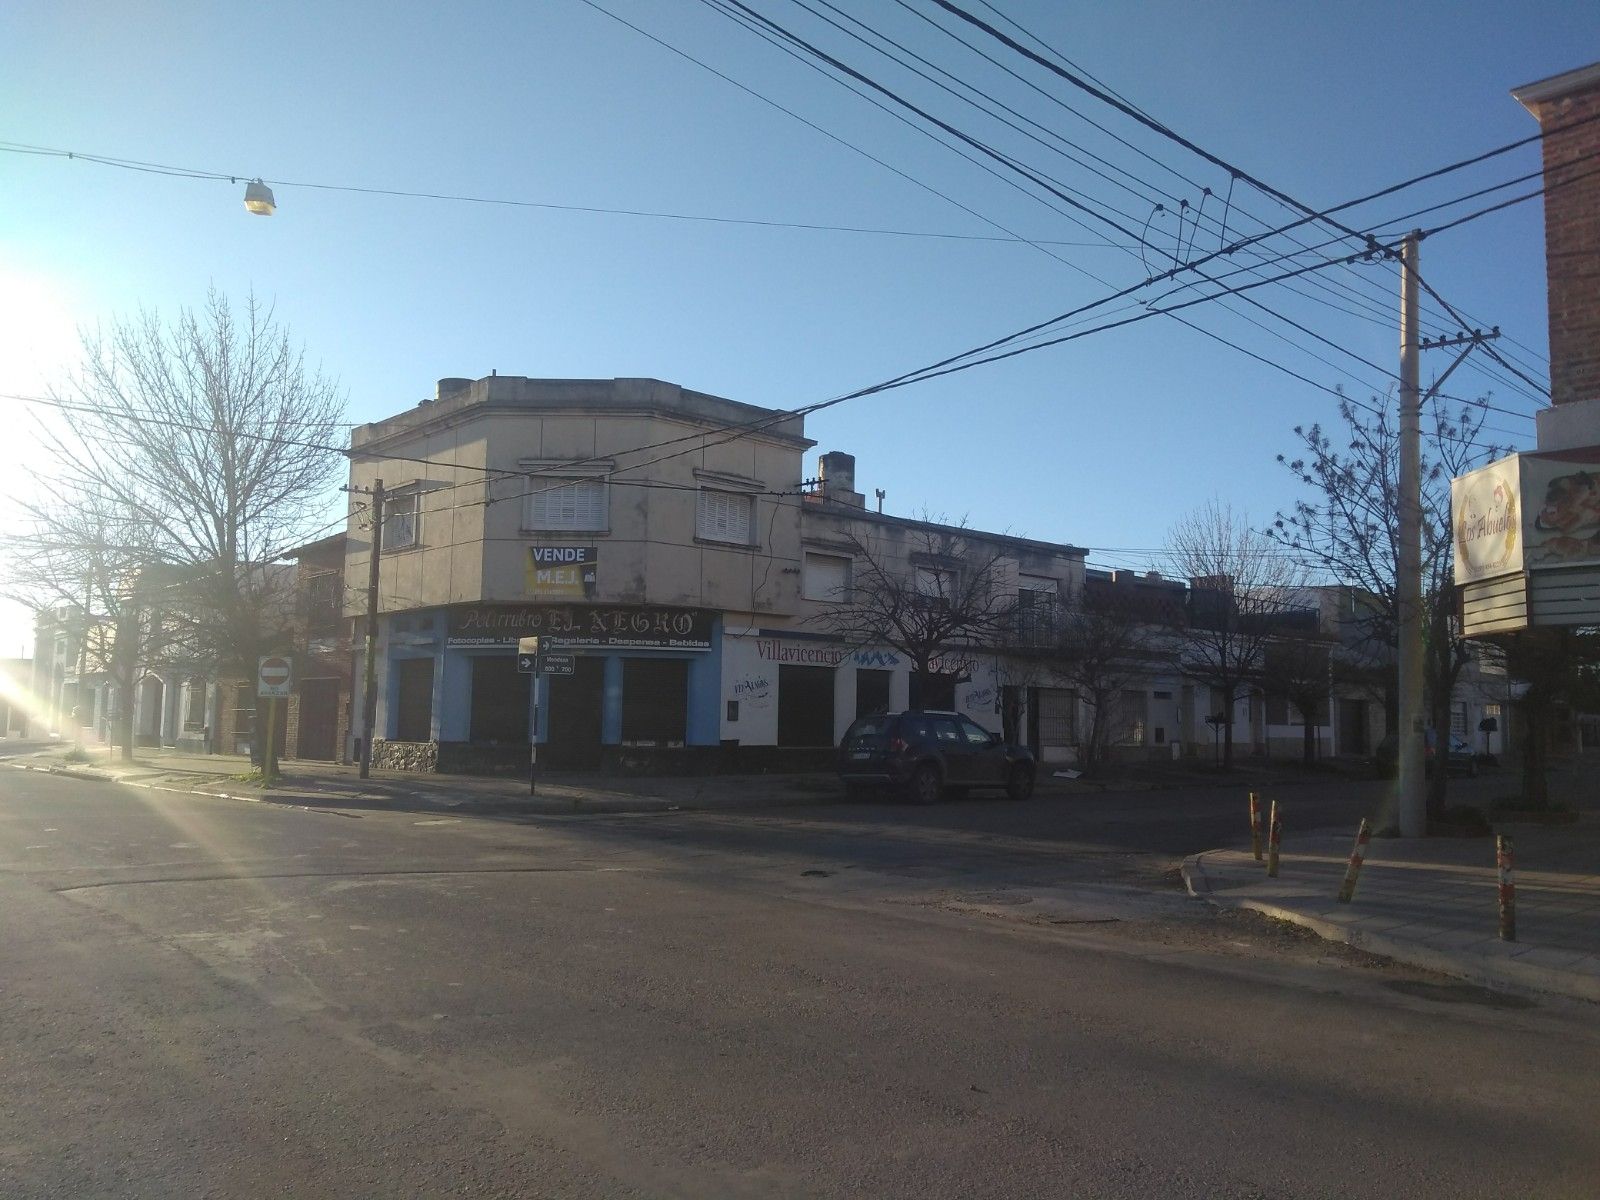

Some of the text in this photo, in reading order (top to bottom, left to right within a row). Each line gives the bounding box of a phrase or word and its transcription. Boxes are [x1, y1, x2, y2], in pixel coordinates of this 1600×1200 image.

[532, 547, 585, 562] VENDE
[608, 637, 661, 648] Despensa
[669, 640, 709, 648] Bebidas
[756, 640, 840, 664] Villavicencio
